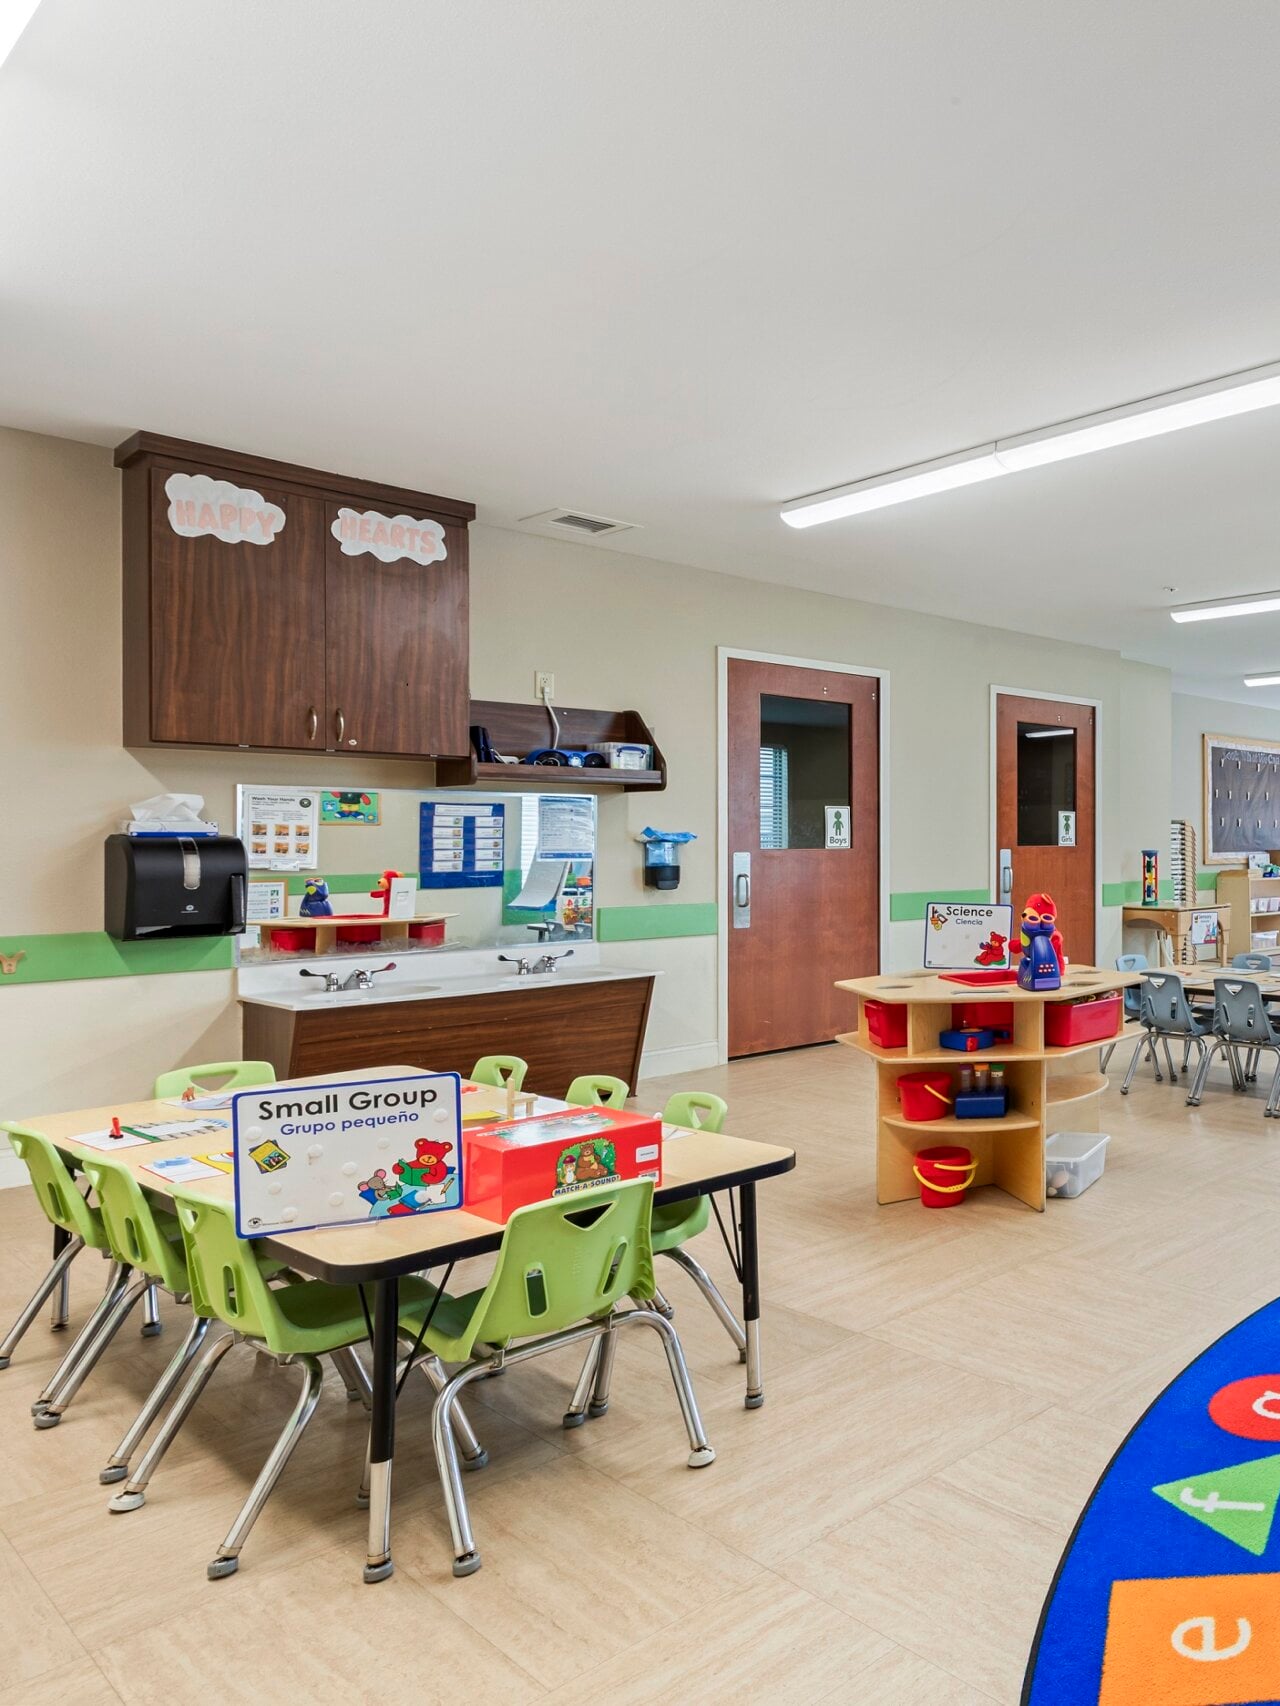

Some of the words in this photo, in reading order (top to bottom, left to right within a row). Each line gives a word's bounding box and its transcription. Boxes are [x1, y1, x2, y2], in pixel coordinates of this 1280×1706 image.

[175, 499, 277, 538] HAPPY
[339, 516, 438, 555] HEARTS
[829, 836, 848, 846] Boys
[1061, 835, 1073, 843] Girls
[946, 906, 993, 917] Science
[955, 918, 983, 926] Ciencia
[258, 1094, 339, 1121] Small
[349, 1088, 437, 1111] Group
[280, 1121, 336, 1136] Grupo
[341, 1111, 419, 1132] pequeño
[554, 1175, 620, 1196] MATCH-A-SOUND!
[1180, 1487, 1266, 1514] f
[1171, 1615, 1252, 1663] e
